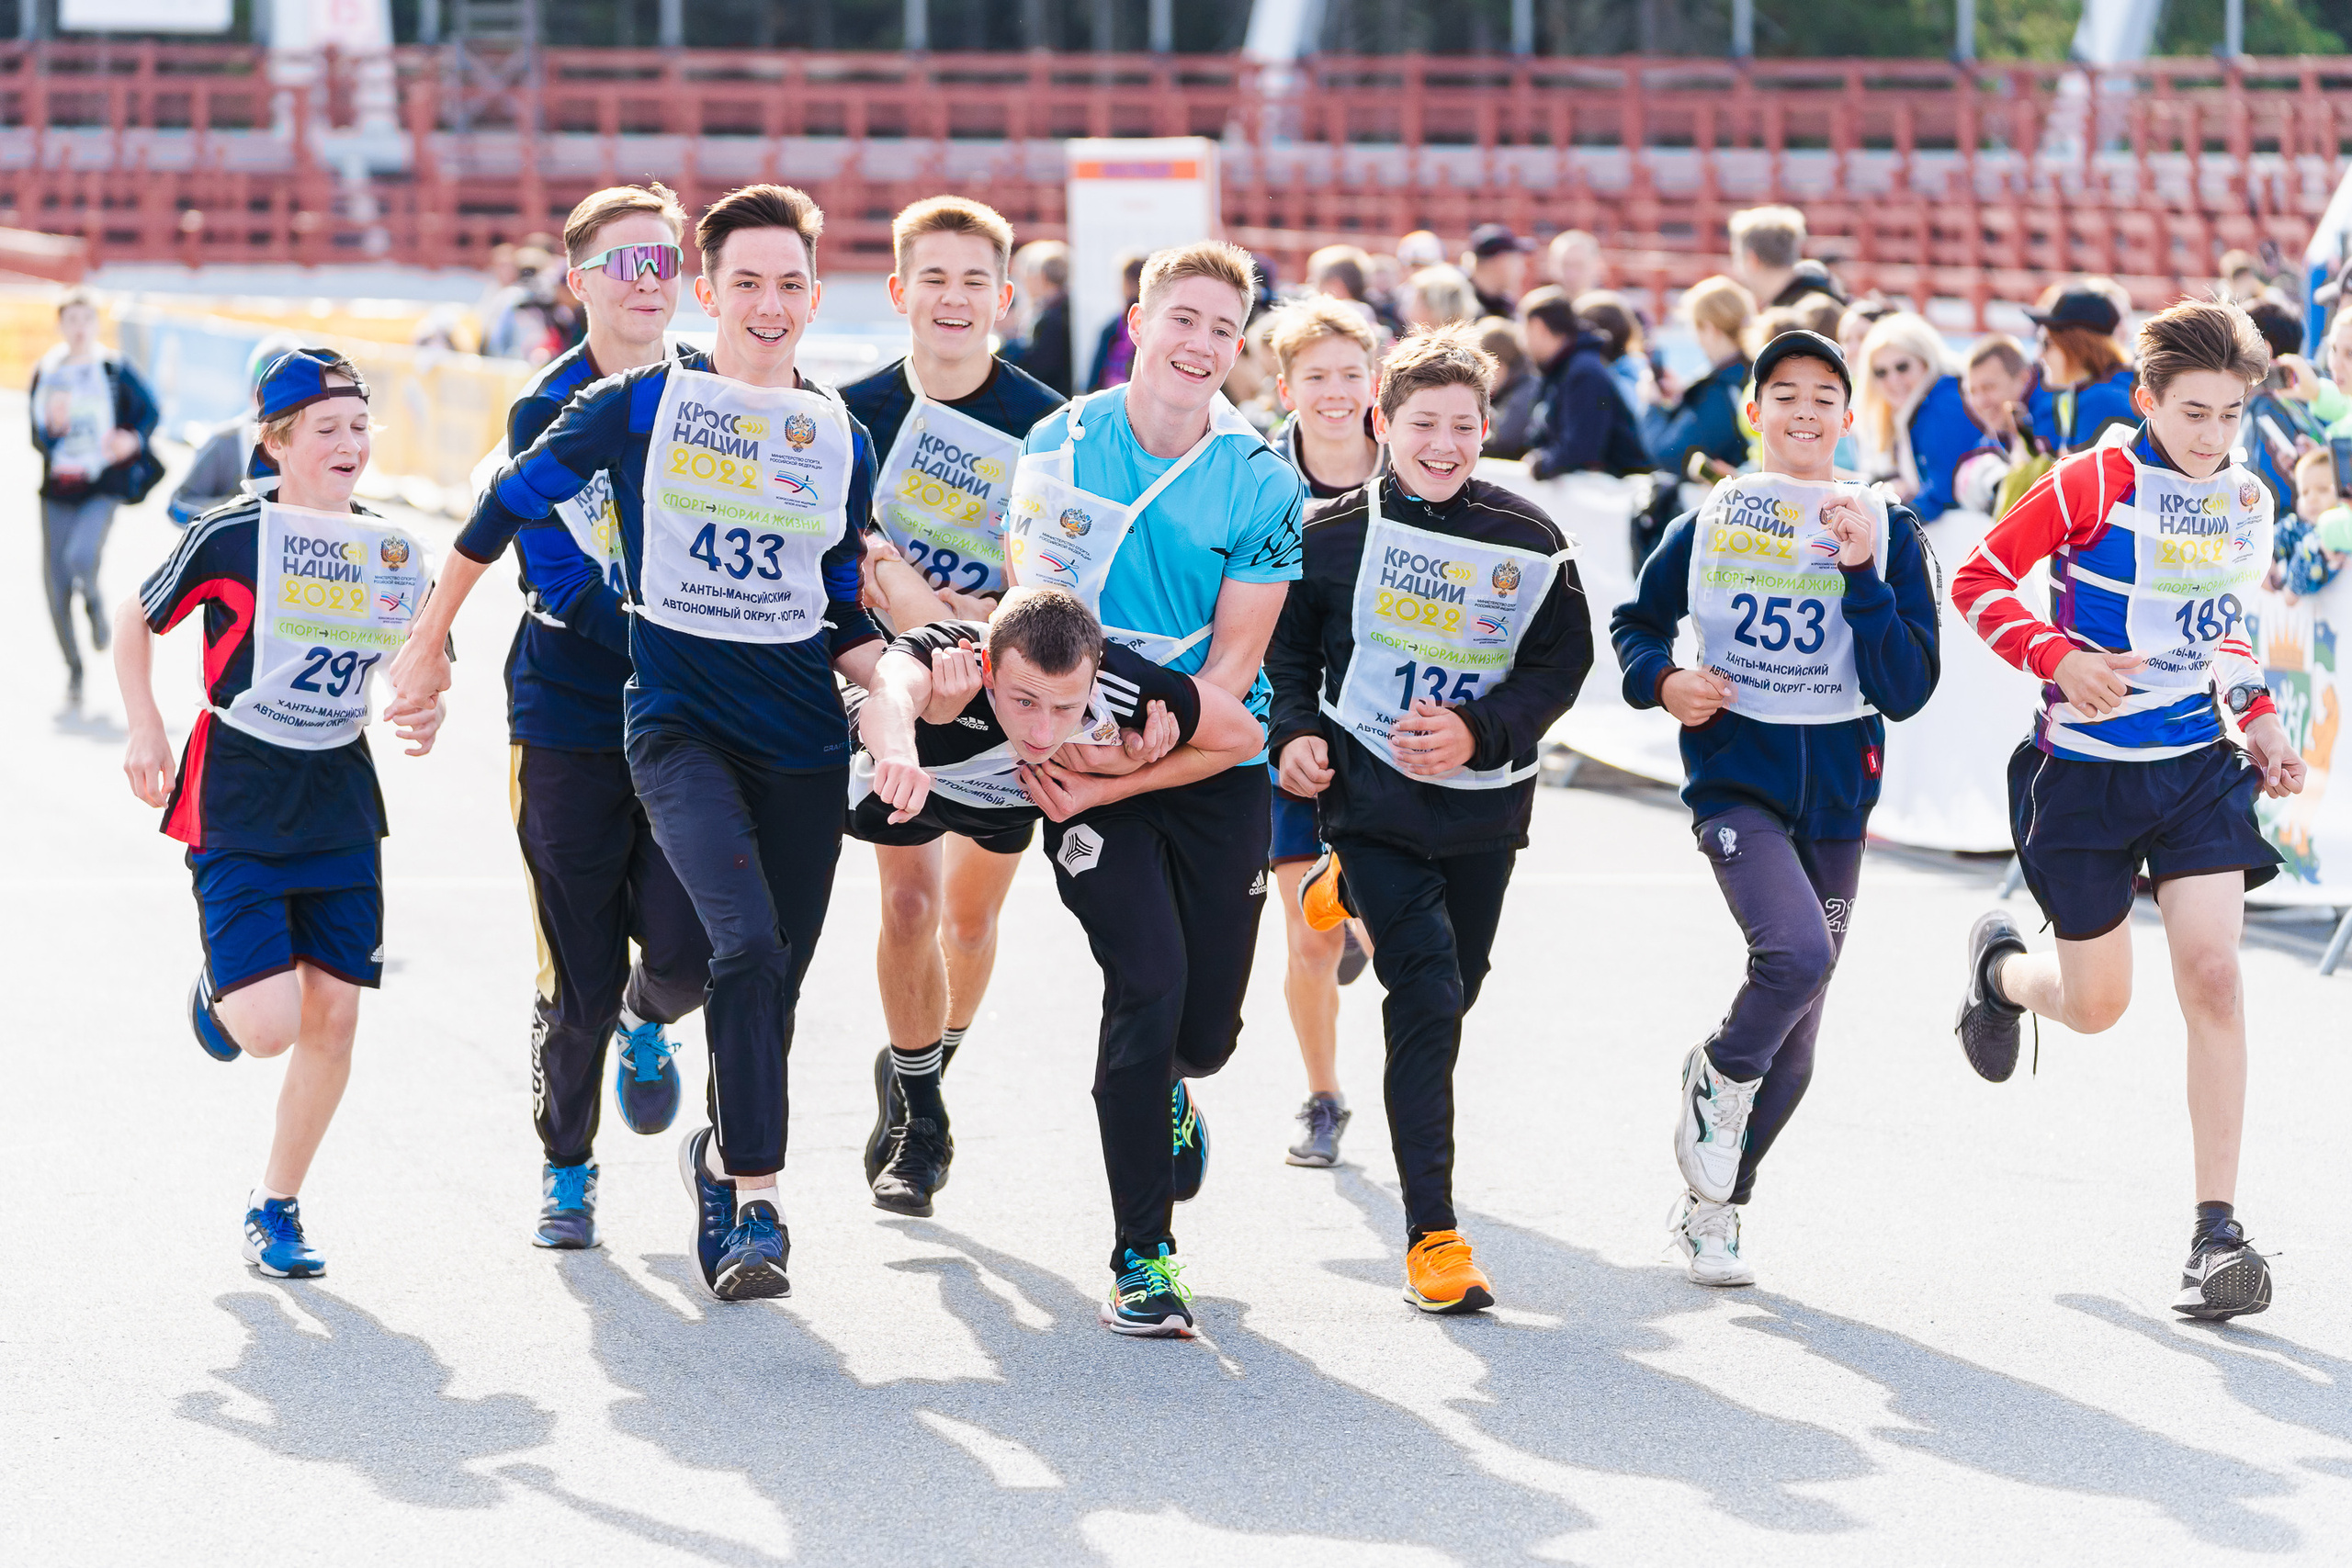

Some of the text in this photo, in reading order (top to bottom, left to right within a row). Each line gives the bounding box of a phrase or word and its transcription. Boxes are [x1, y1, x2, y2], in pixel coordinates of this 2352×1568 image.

[677, 400, 741, 434] КРОСС
[673, 422, 759, 461] НАЦИИ
[918, 432, 981, 473] КРОСС
[670, 447, 758, 490] 2022
[910, 451, 992, 501] НАЦИИ
[662, 491, 707, 513] СПОРТ
[901, 475, 981, 522] 2022
[1719, 489, 1781, 516] КРОСС
[1714, 505, 1794, 538] НАЦИИ
[2160, 514, 2229, 537] НАЦИИ
[284, 535, 349, 560] КРОСС
[688, 522, 786, 581] 433
[1712, 529, 1792, 559] 2022
[2160, 537, 2224, 564] 2022
[283, 556, 363, 583] НАЦИИ
[1384, 546, 1450, 580] КРОСС
[680, 581, 791, 604] ХАНТЫ-МАНСИЙСКИЙ
[1380, 567, 1466, 604] НАЦИИ
[1706, 570, 1745, 585] СПОРТ
[1808, 579, 1845, 592] ЖИЗН
[2157, 582, 2193, 593] СПОРТ
[284, 580, 364, 613] 2022
[662, 597, 741, 619] АВТОНОМНЫЙ
[1374, 592, 1461, 633] 2022
[1730, 592, 1826, 654] 253
[279, 622, 320, 638] СПОРТ
[374, 632, 409, 646] ЖИЗН
[1370, 631, 1408, 652] СПОРТ
[1709, 663, 1770, 690] АВТОНОМНЫЙ
[1772, 682, 1805, 694] ОКРУГ
[1813, 682, 1843, 694] ЮГРА
[1725, 650, 1828, 677] ХАНТЫ-МАНСИЙСКИЙ
[1395, 660, 1480, 712] 135
[934, 777, 1005, 807] ВТОНОМНЫЙ
